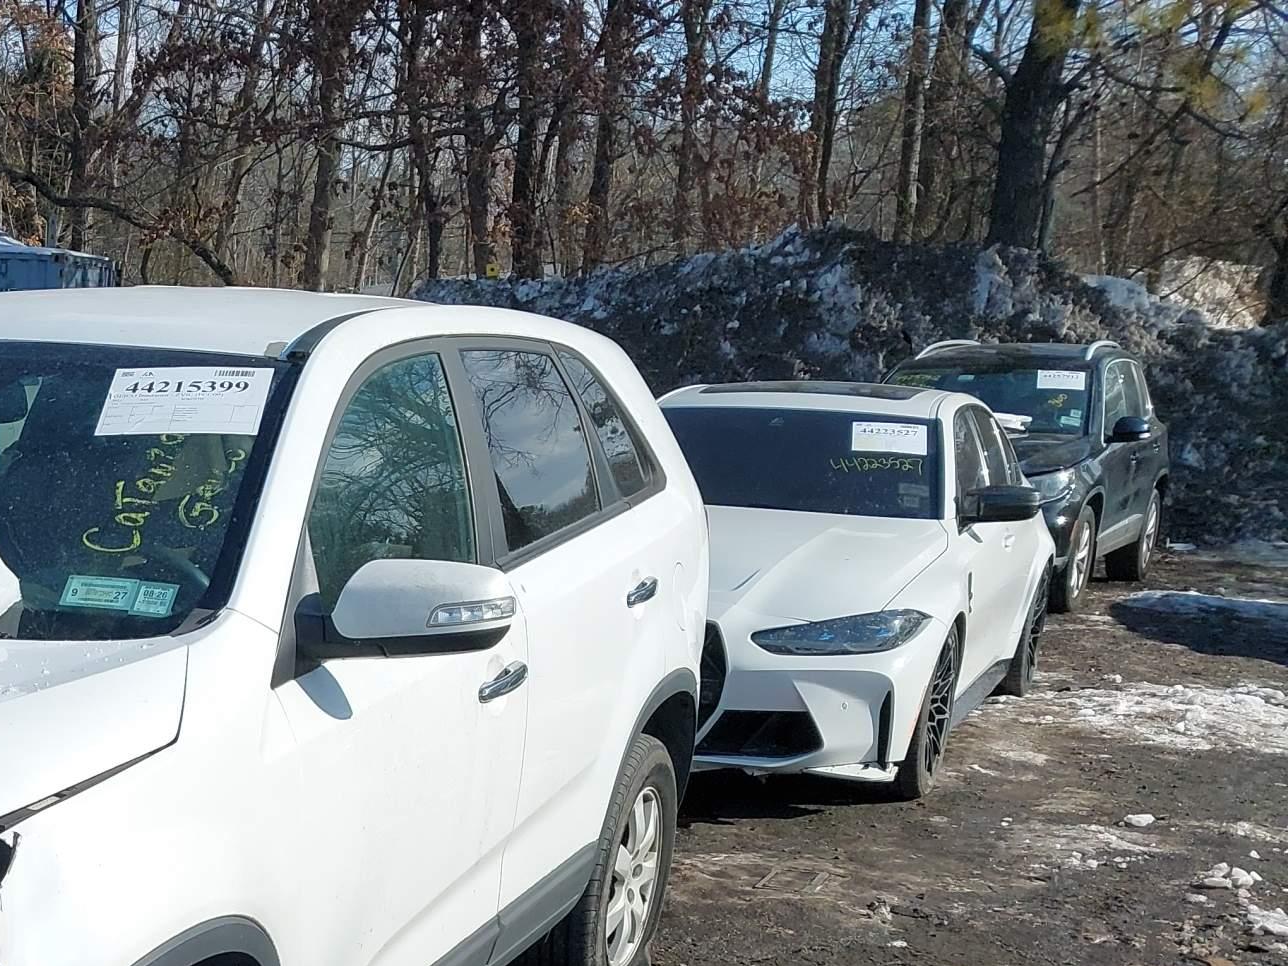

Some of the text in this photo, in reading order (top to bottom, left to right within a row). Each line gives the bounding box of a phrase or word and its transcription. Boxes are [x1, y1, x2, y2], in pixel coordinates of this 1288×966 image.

[125, 380, 250, 394] 44215399
[859, 428, 918, 437] 44223527
[830, 456, 923, 476] 44223527
[71, 588, 79, 597] 9
[113, 591, 129, 600] 27
